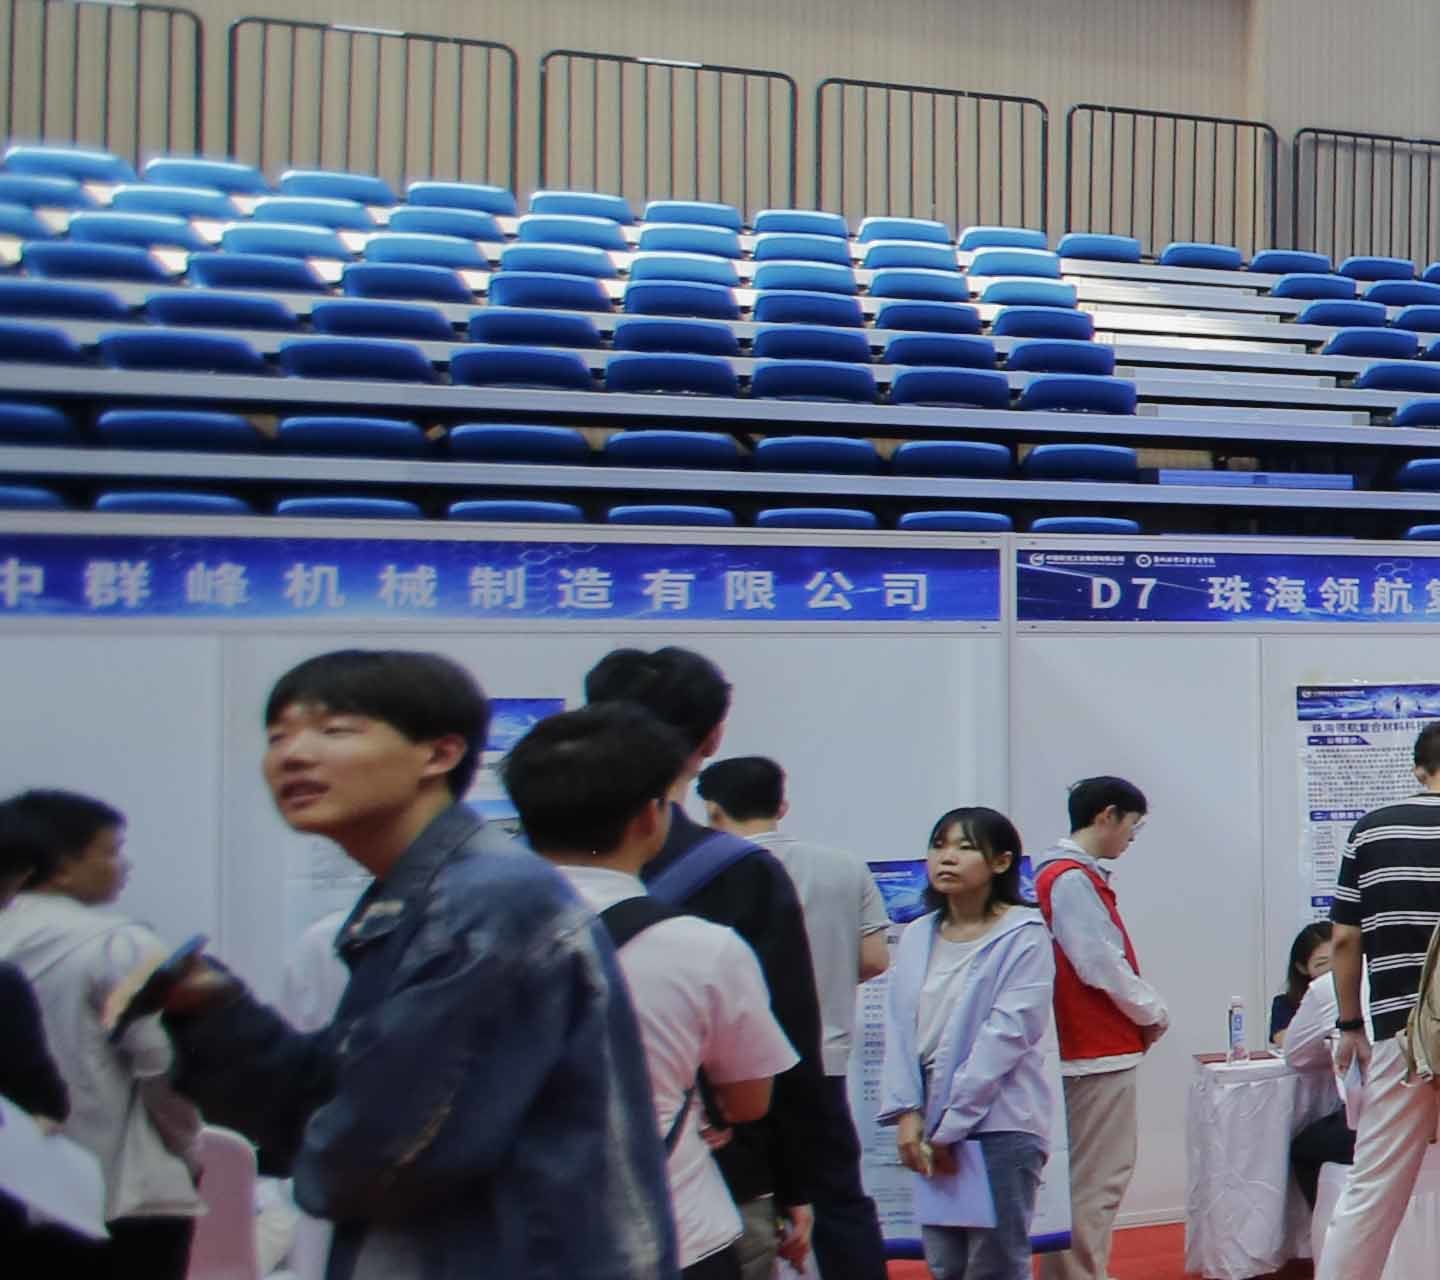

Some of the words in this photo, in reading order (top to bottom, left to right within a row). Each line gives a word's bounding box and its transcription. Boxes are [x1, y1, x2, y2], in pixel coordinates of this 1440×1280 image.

[0, 558, 928, 611] 中群峰机械制造有限公司
[1091, 577, 1157, 609] D7
